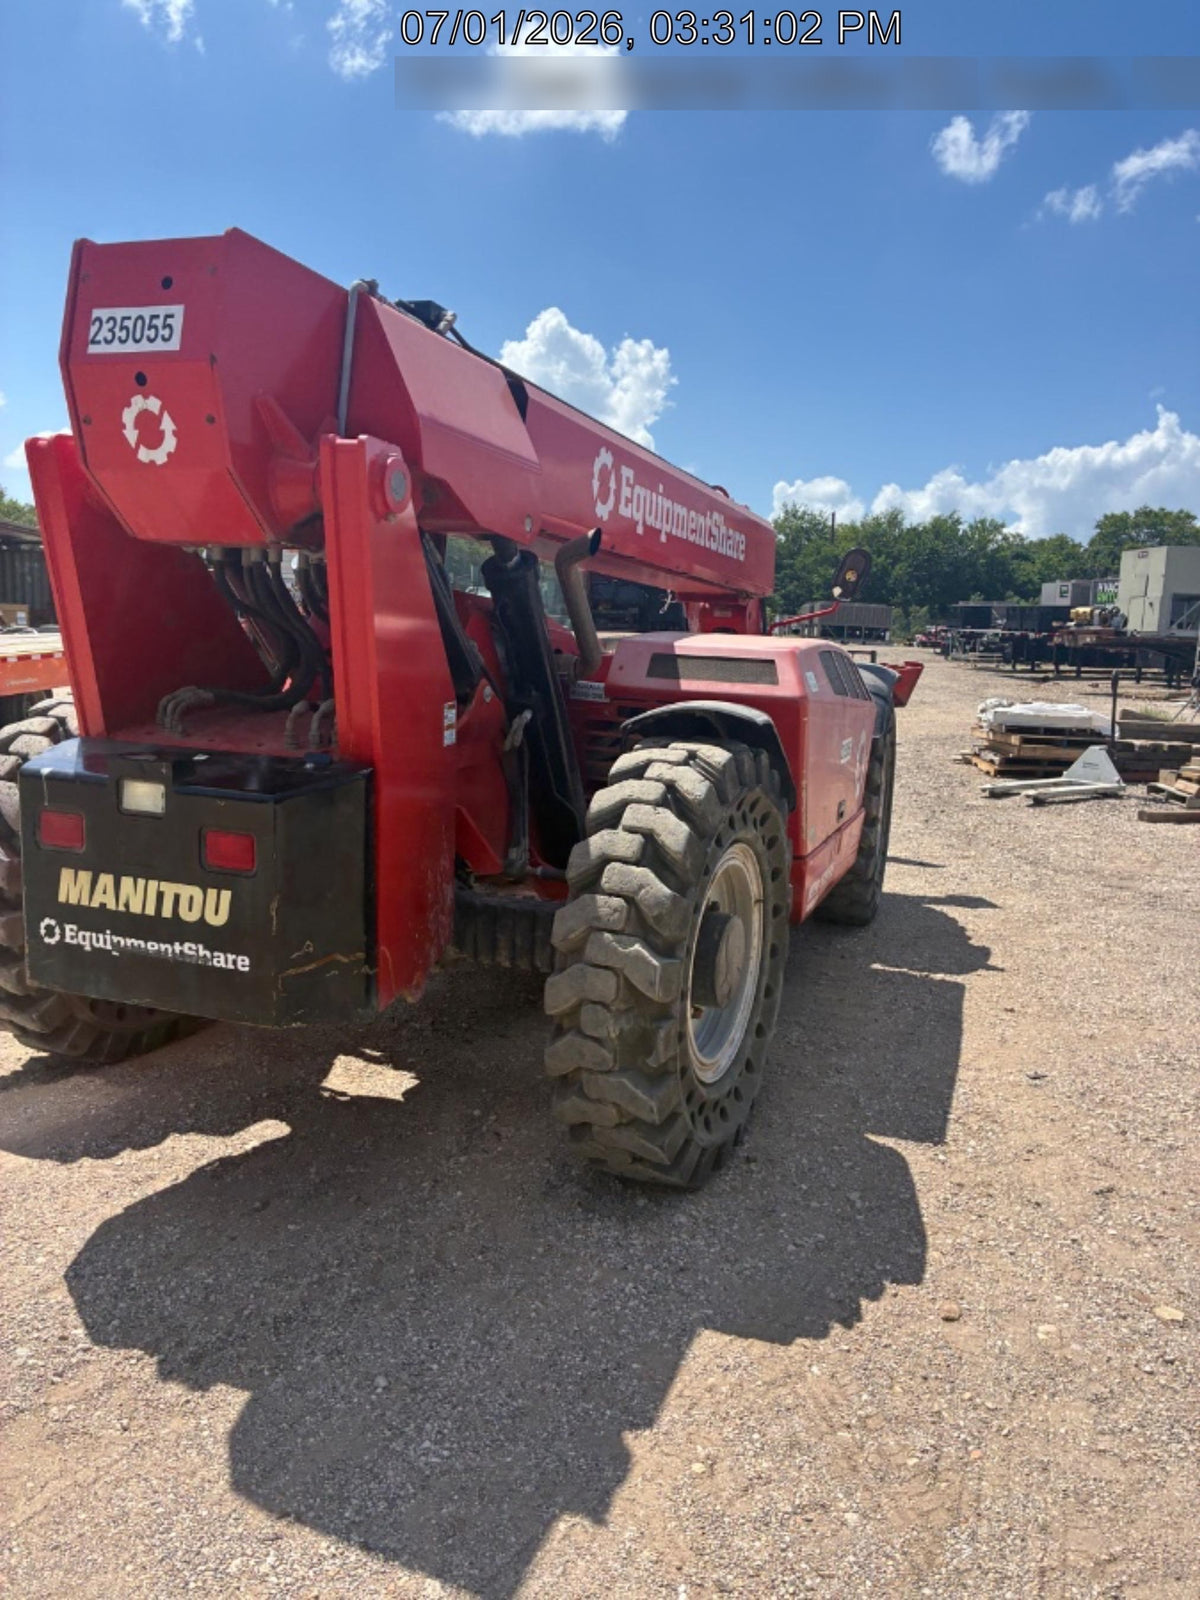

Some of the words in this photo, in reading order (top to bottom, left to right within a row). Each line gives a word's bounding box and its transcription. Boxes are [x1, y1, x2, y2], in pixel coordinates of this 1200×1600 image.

[89, 313, 175, 346] 235055
[618, 465, 746, 562] EquipmentShare
[58, 867, 232, 927] MANITOU
